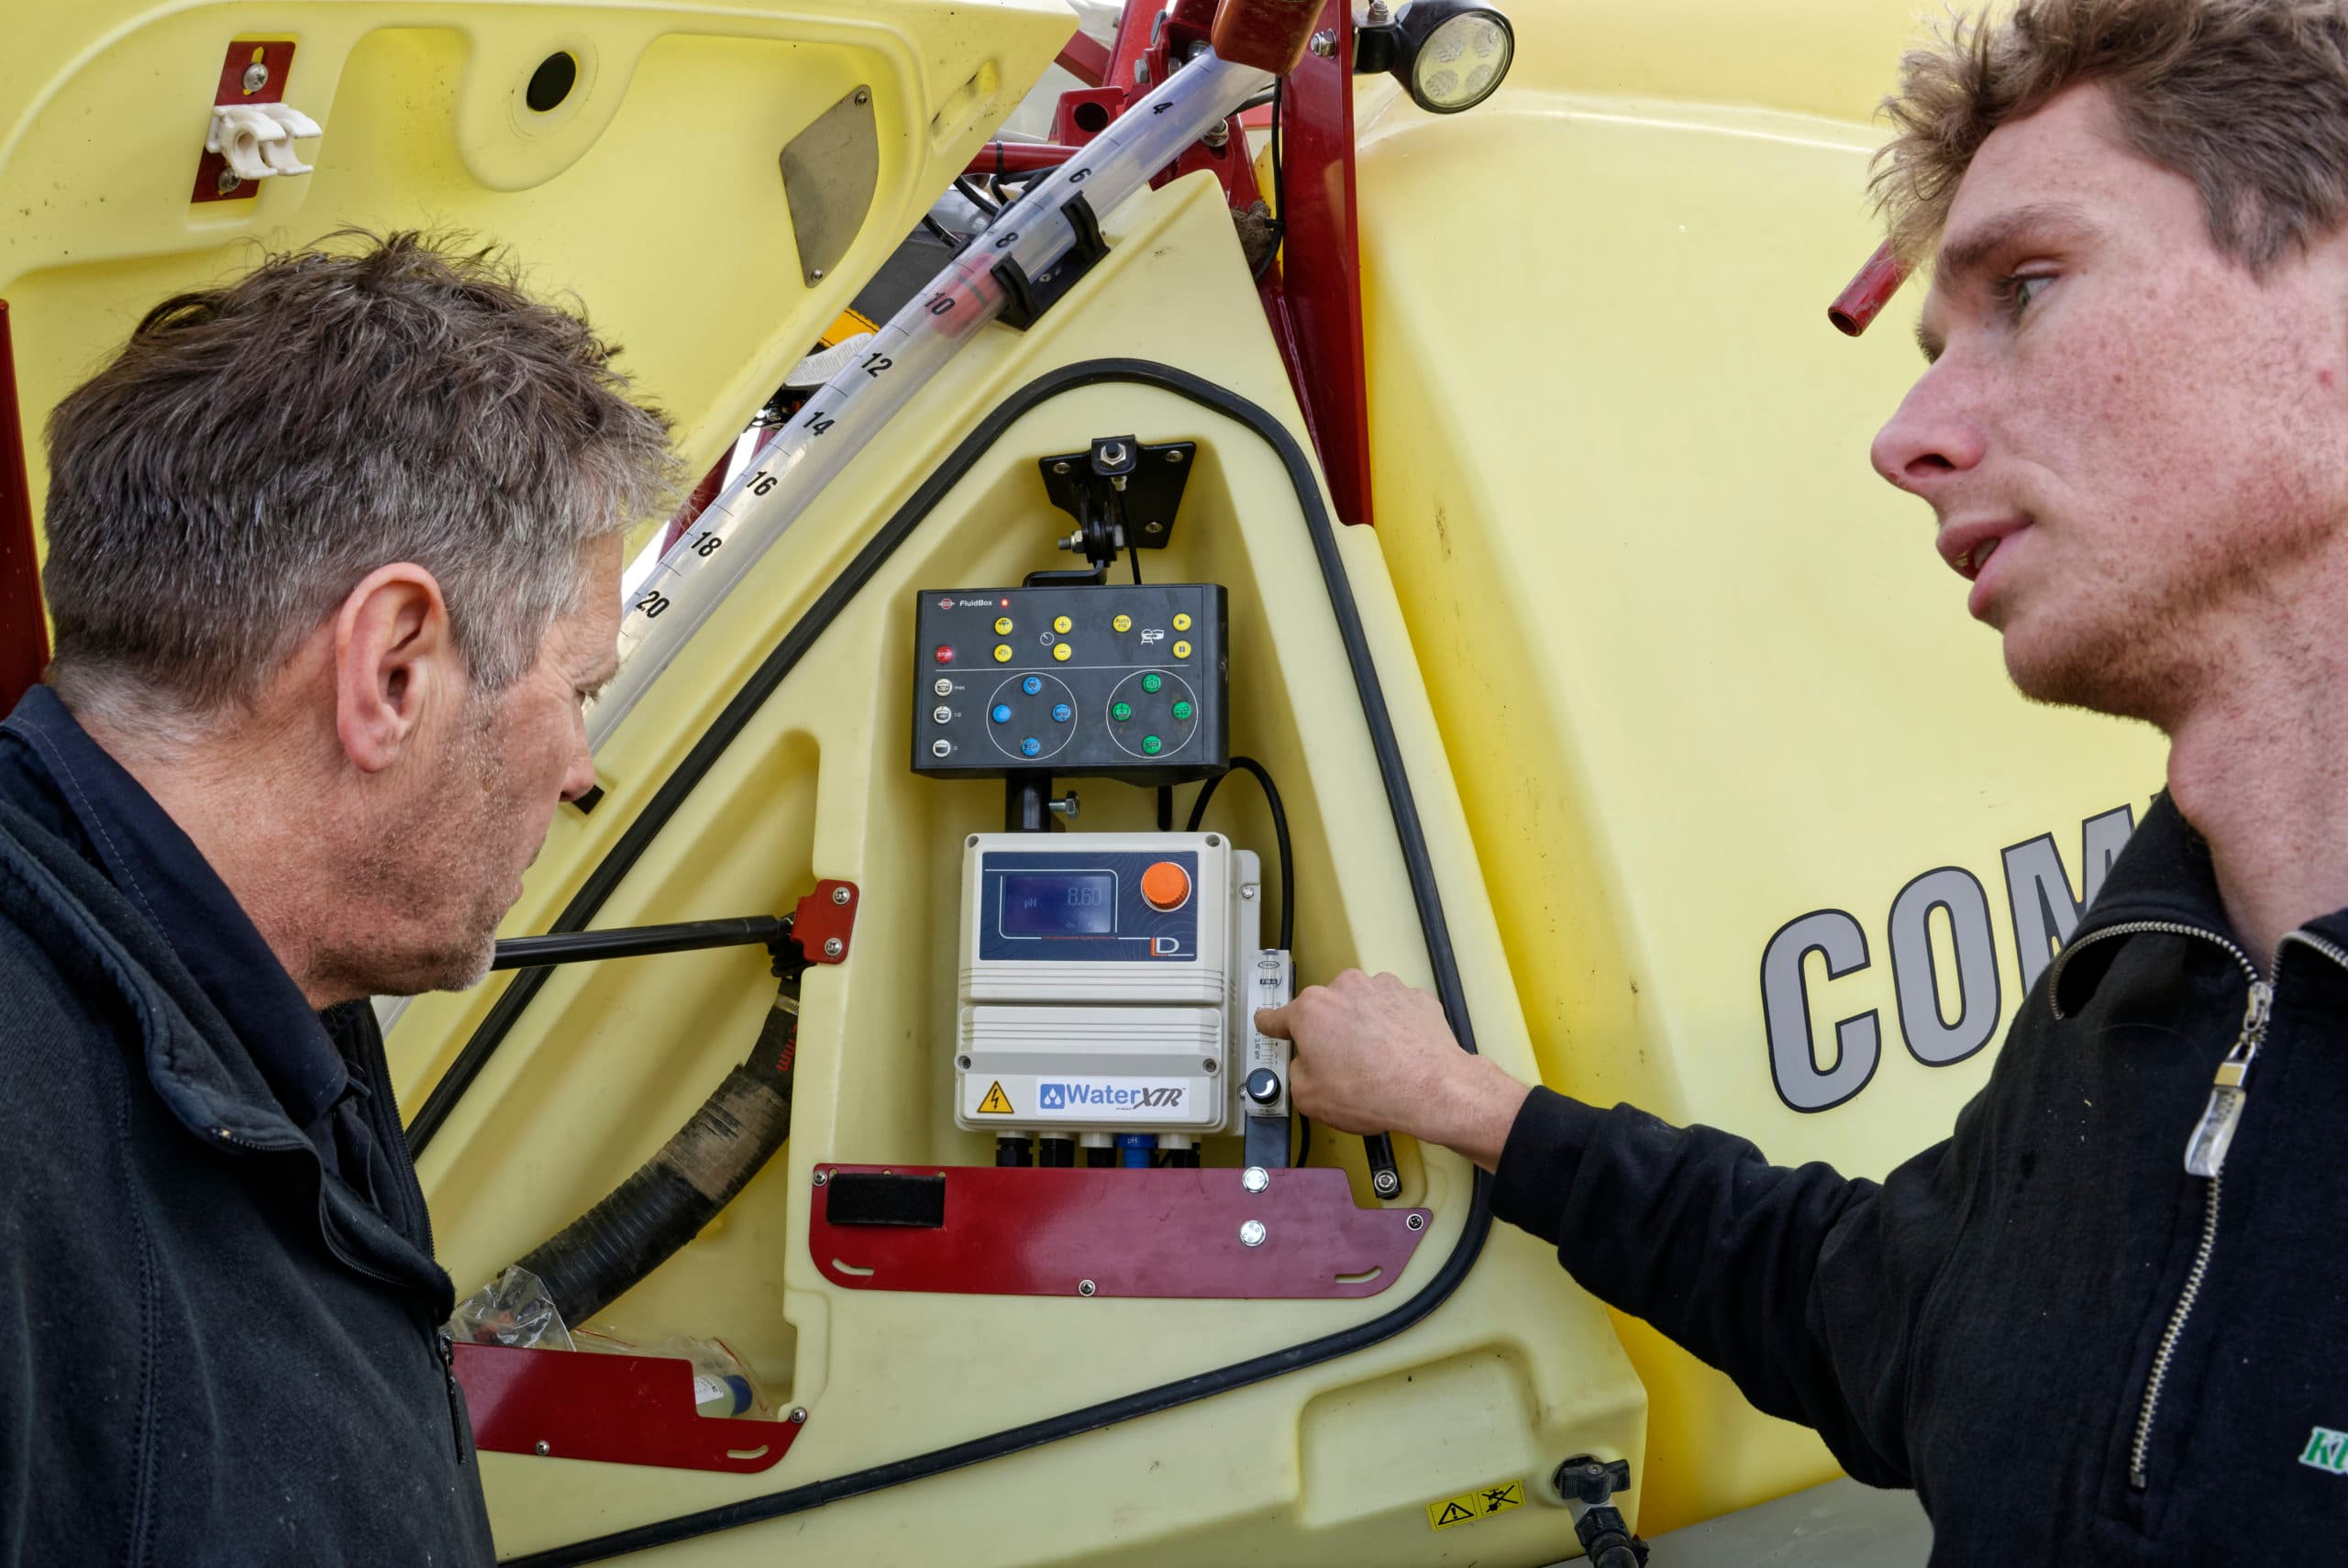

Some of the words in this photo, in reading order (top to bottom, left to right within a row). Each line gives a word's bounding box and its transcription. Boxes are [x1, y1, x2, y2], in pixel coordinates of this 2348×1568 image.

[1153, 101, 1174, 116] 4
[1069, 168, 1092, 183] 6
[995, 232, 1019, 248] 8
[925, 292, 956, 315] 10
[861, 352, 893, 378] 12
[803, 411, 836, 436] 14
[747, 470, 779, 496] 16
[691, 531, 723, 558] 18
[636, 591, 670, 619] 20
[1023, 898, 1037, 909] pH
[1759, 792, 2159, 1114] COM
